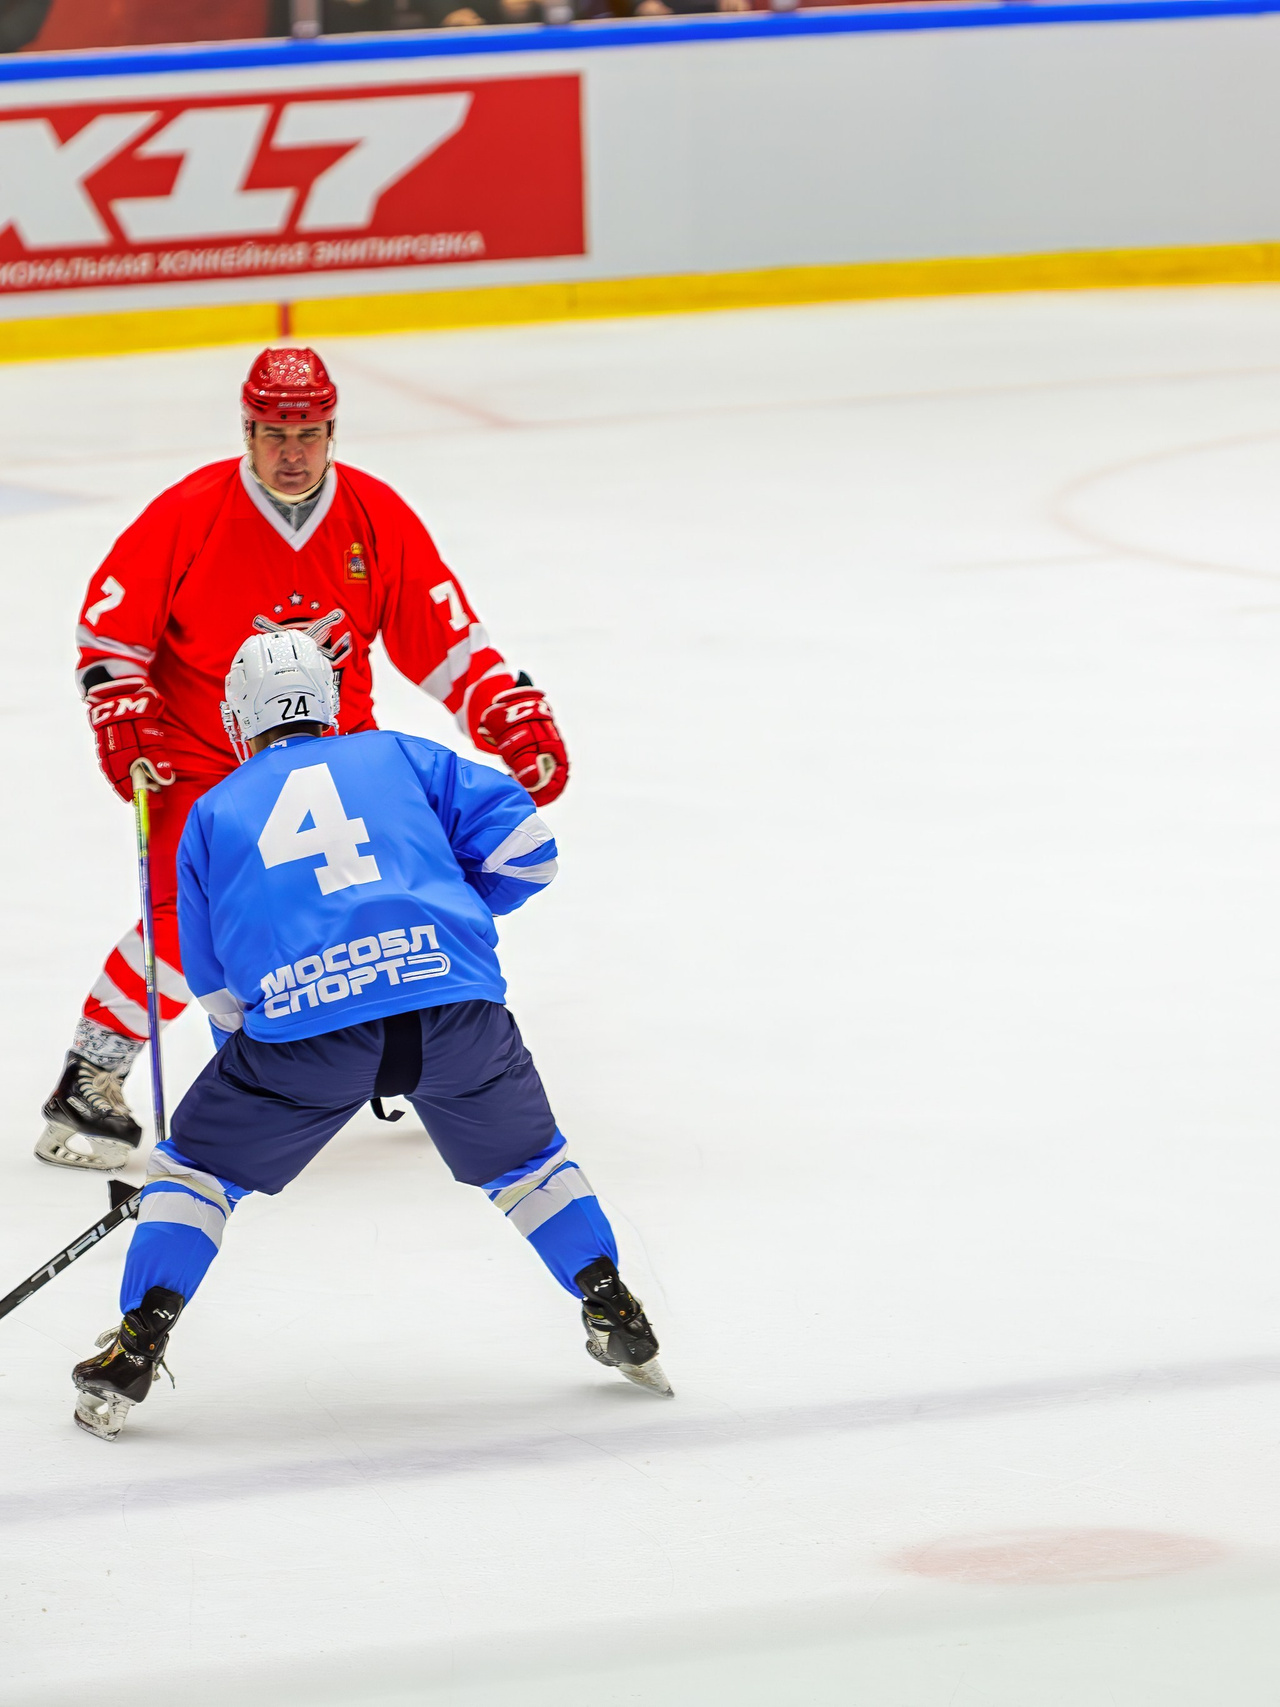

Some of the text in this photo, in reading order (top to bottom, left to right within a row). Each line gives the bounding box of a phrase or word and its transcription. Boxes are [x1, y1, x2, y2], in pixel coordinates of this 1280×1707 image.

[428, 580, 471, 632] 7
[277, 695, 311, 721] 24
[257, 762, 382, 896] 4
[260, 924, 441, 1000] МОСОБЛ
[263, 957, 406, 1020] СПОРТ
